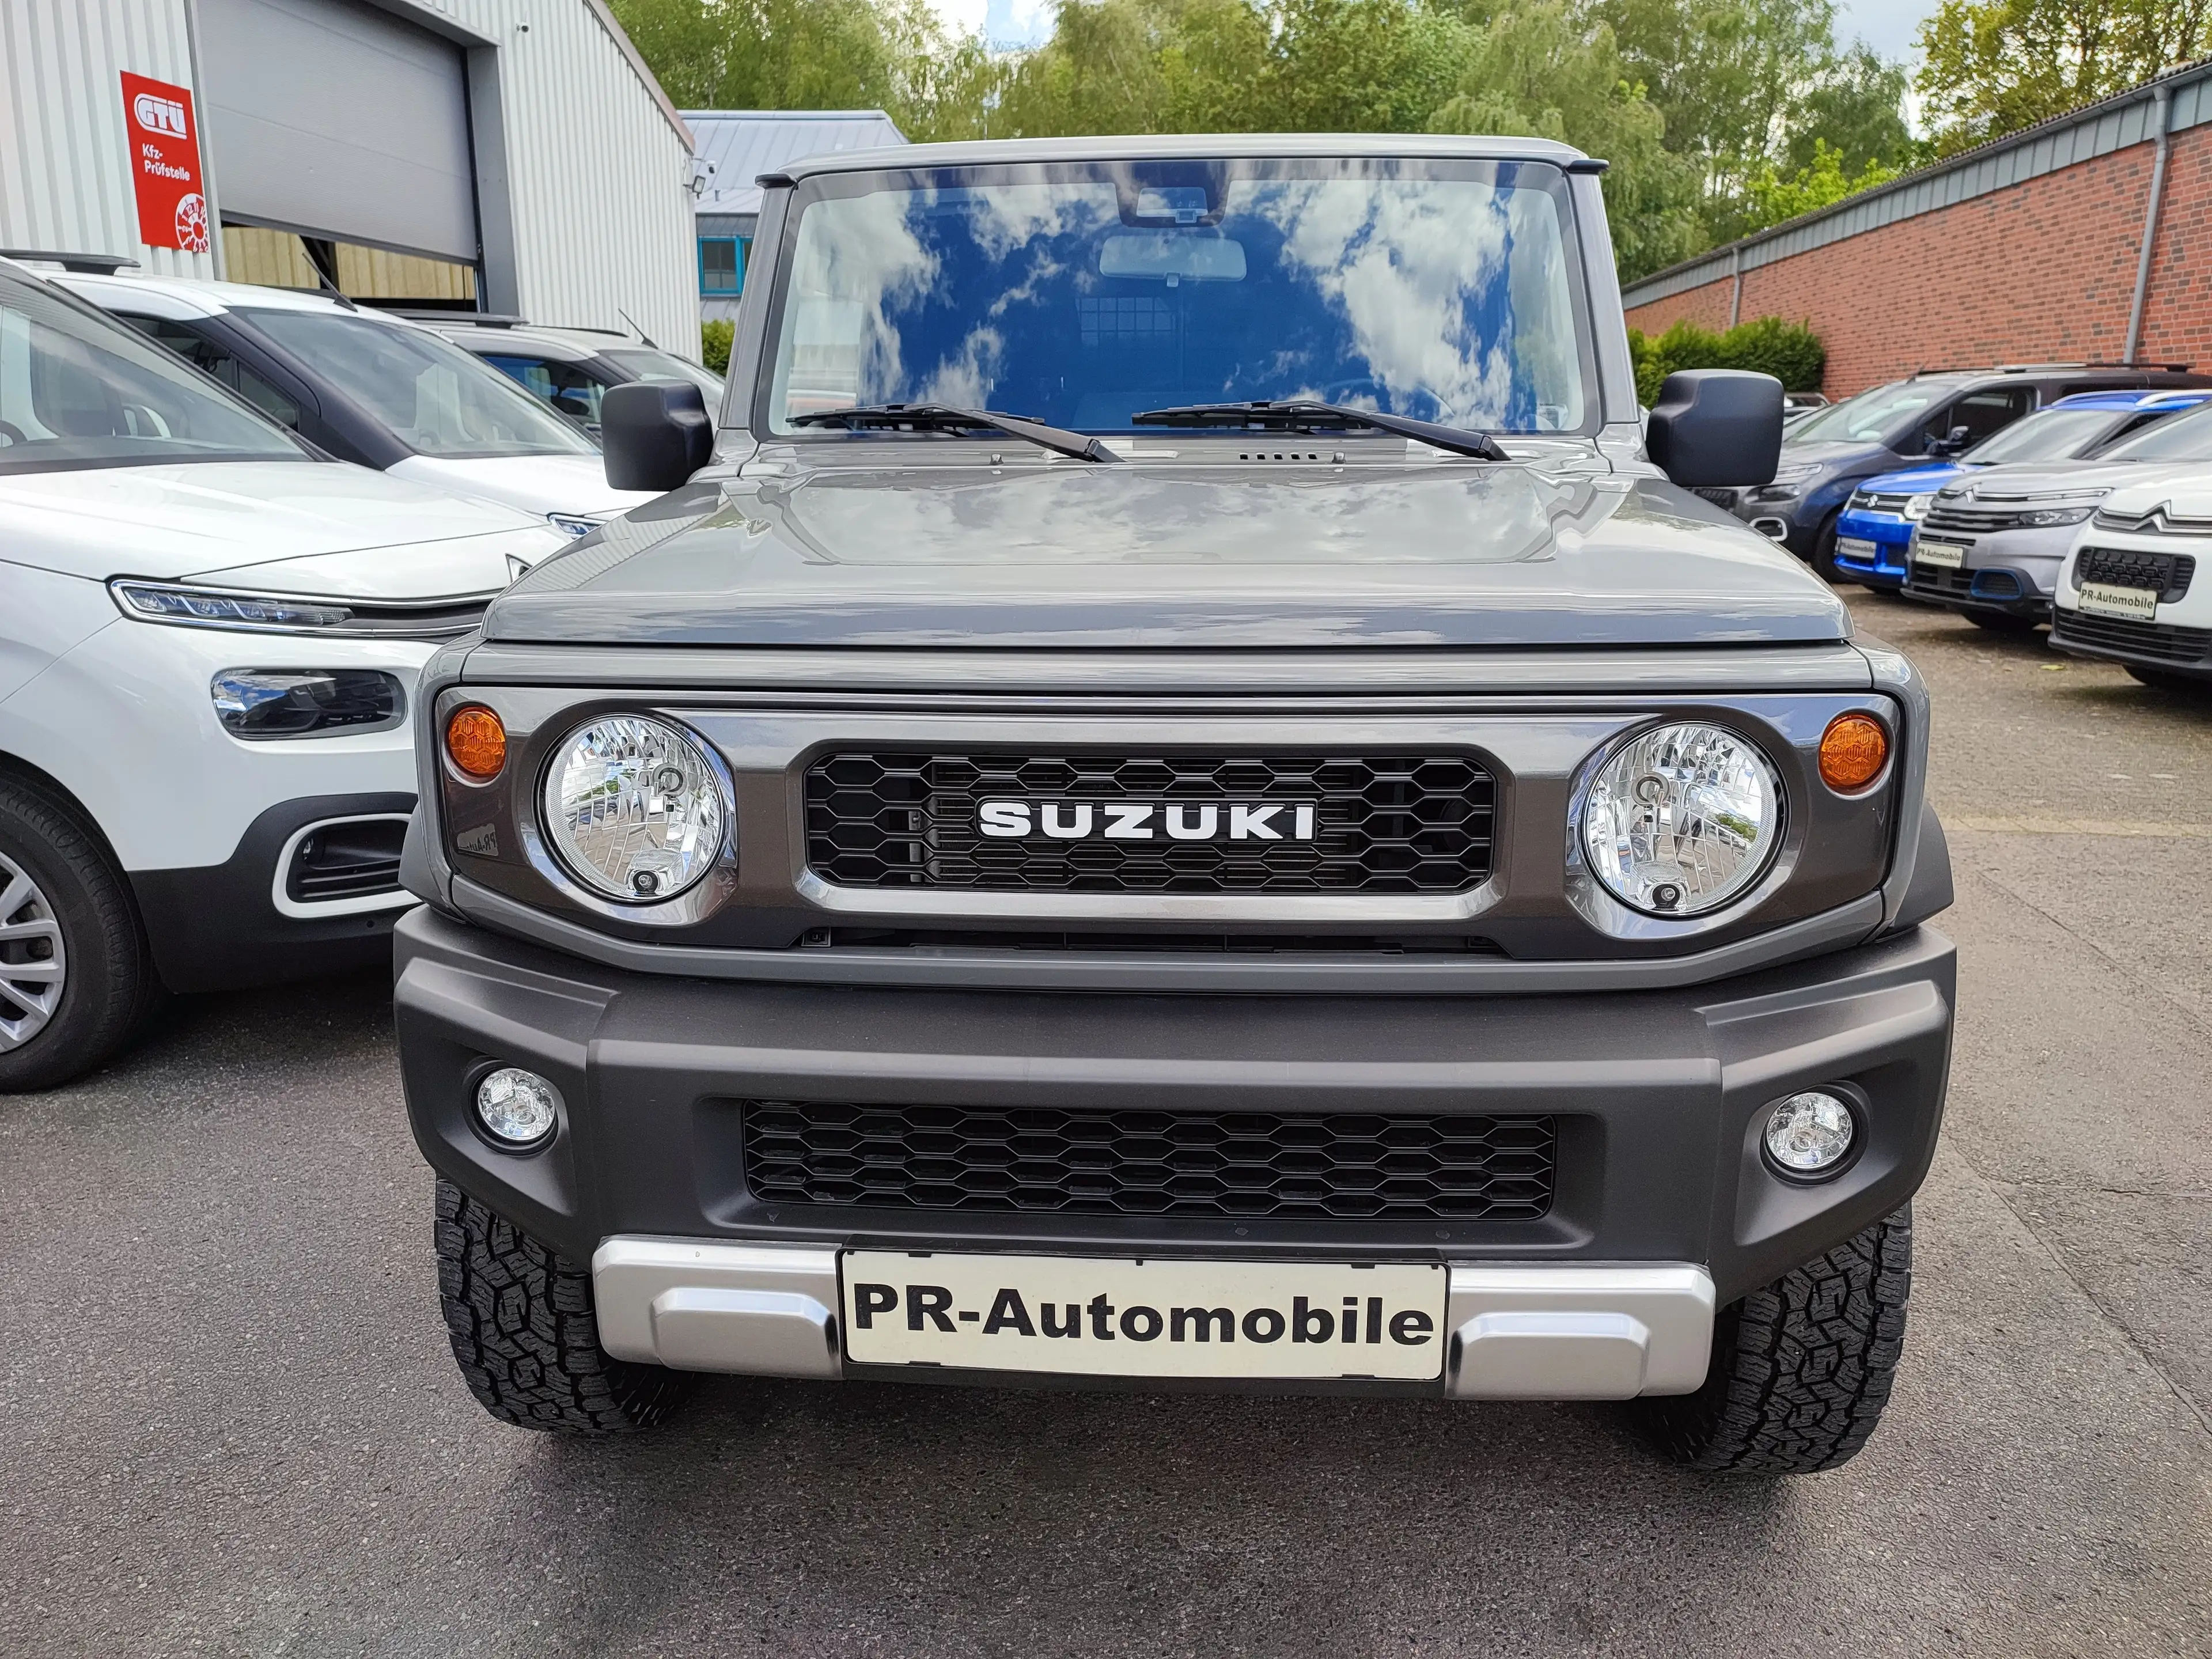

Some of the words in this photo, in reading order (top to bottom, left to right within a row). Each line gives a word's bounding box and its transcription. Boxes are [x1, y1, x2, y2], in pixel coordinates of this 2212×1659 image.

[135, 94, 187, 137] GTÜ
[142, 143, 163, 160] Kfz-
[144, 160, 190, 181] Prüfstelle
[1917, 548, 1960, 560] PR-Automobile
[2081, 589, 2153, 609] PR-Automobile
[980, 802, 1313, 839] SUZUKI
[854, 1283, 1434, 1345] PR-Automobile
